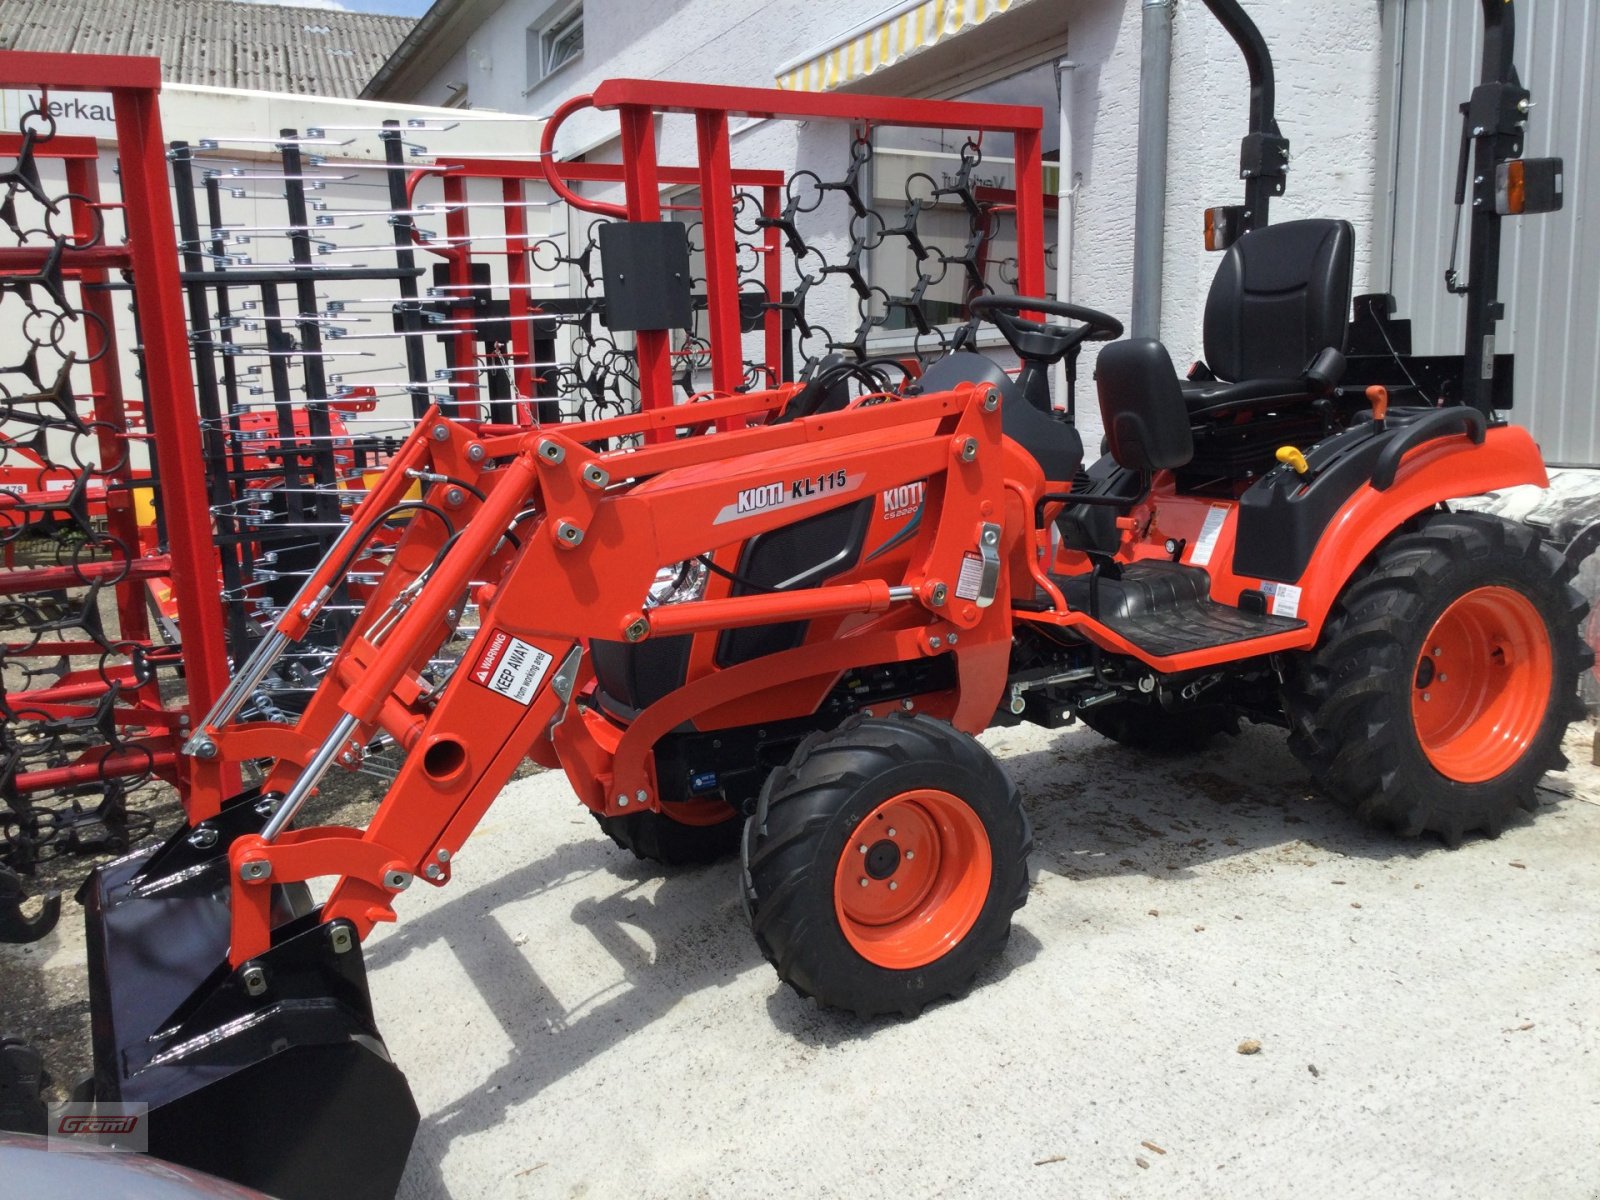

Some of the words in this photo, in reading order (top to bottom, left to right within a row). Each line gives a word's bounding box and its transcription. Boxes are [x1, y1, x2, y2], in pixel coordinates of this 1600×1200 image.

[737, 481, 784, 514] KIOTI
[791, 469, 846, 499] KL115
[883, 481, 923, 512] KIOTI
[482, 633, 506, 669] WARNING
[495, 668, 515, 693] KEEP
[507, 642, 530, 671] AWAY
[513, 686, 528, 700] from
[524, 661, 541, 687] working
[533, 652, 546, 666] area
